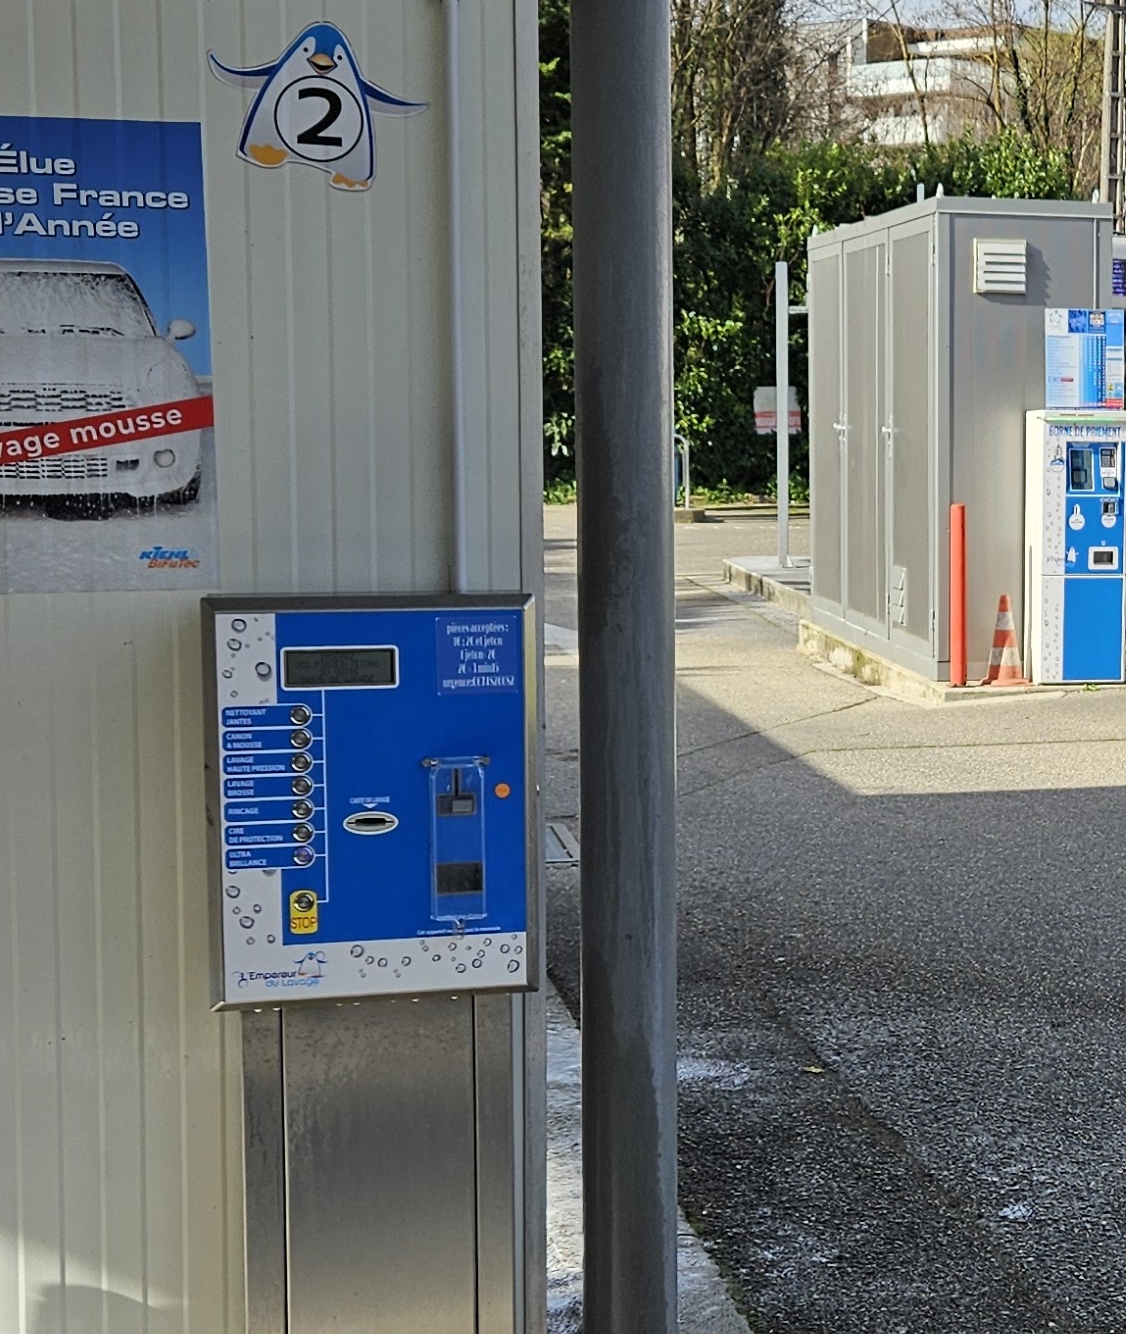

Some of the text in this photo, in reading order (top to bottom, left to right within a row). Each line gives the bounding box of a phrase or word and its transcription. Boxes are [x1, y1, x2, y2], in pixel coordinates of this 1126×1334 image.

[297, 87, 342, 147] 2
[0, 143, 75, 175] Élue
[53, 183, 189, 208] France
[0, 409, 182, 458] age mousse
[1049, 426, 1120, 437] BORNE DE PAIEMENT
[240, 835, 283, 843] PROTECTION
[291, 917, 317, 929] STOP
